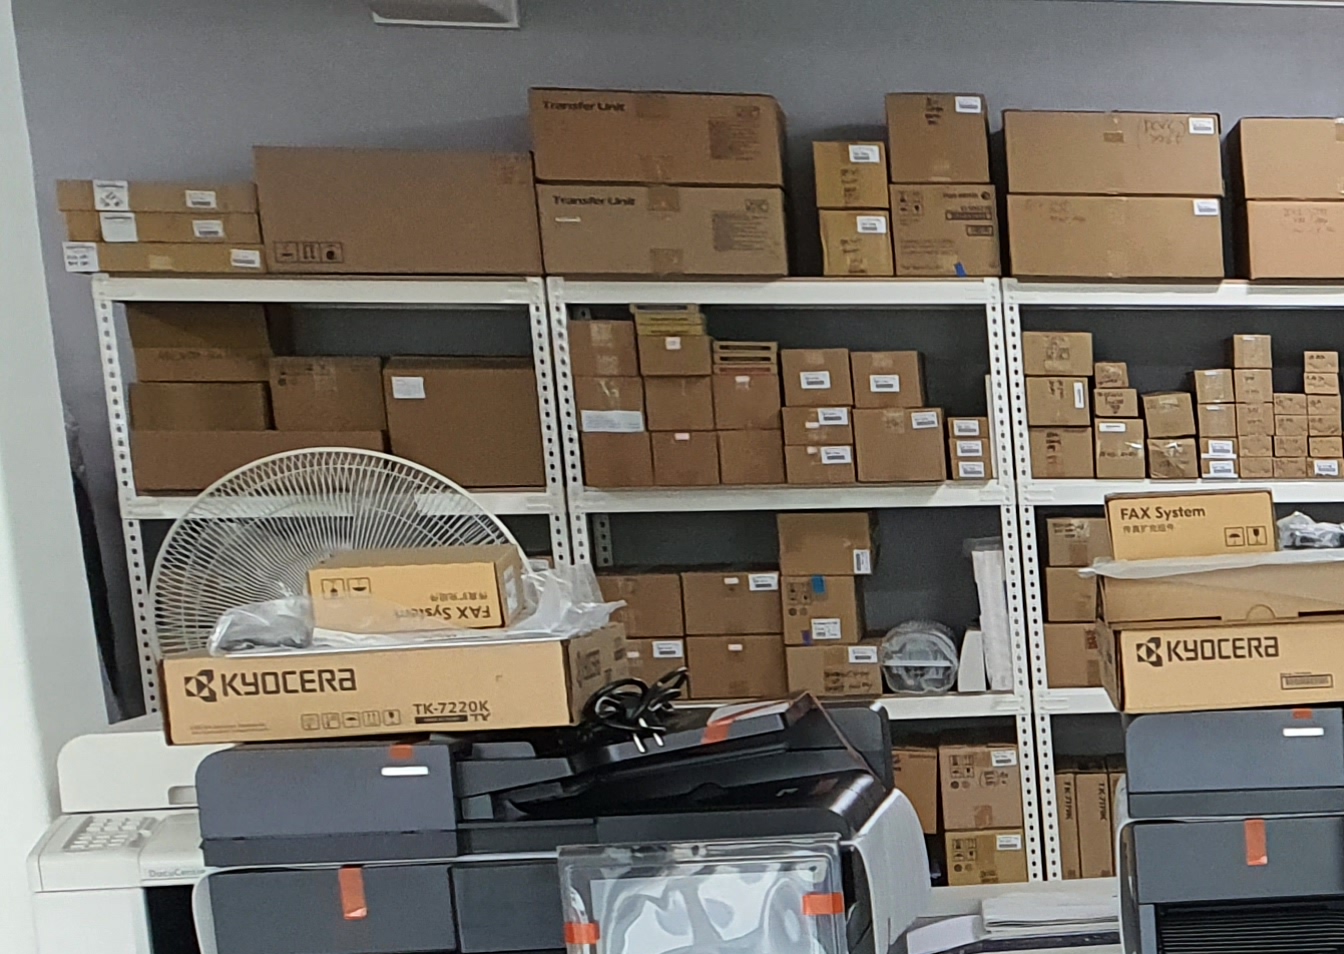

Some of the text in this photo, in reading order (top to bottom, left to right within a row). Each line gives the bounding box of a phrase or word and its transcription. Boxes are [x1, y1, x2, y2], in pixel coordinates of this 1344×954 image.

[543, 100, 625, 112] Transfer Unit
[553, 195, 635, 206] Transfer Unit
[1120, 506, 1206, 521] FAX System
[456, 605, 491, 619] FAX
[1168, 637, 1279, 662] KYOCERA
[221, 668, 357, 697] KYOCERA
[413, 700, 490, 715] TK-7220K
